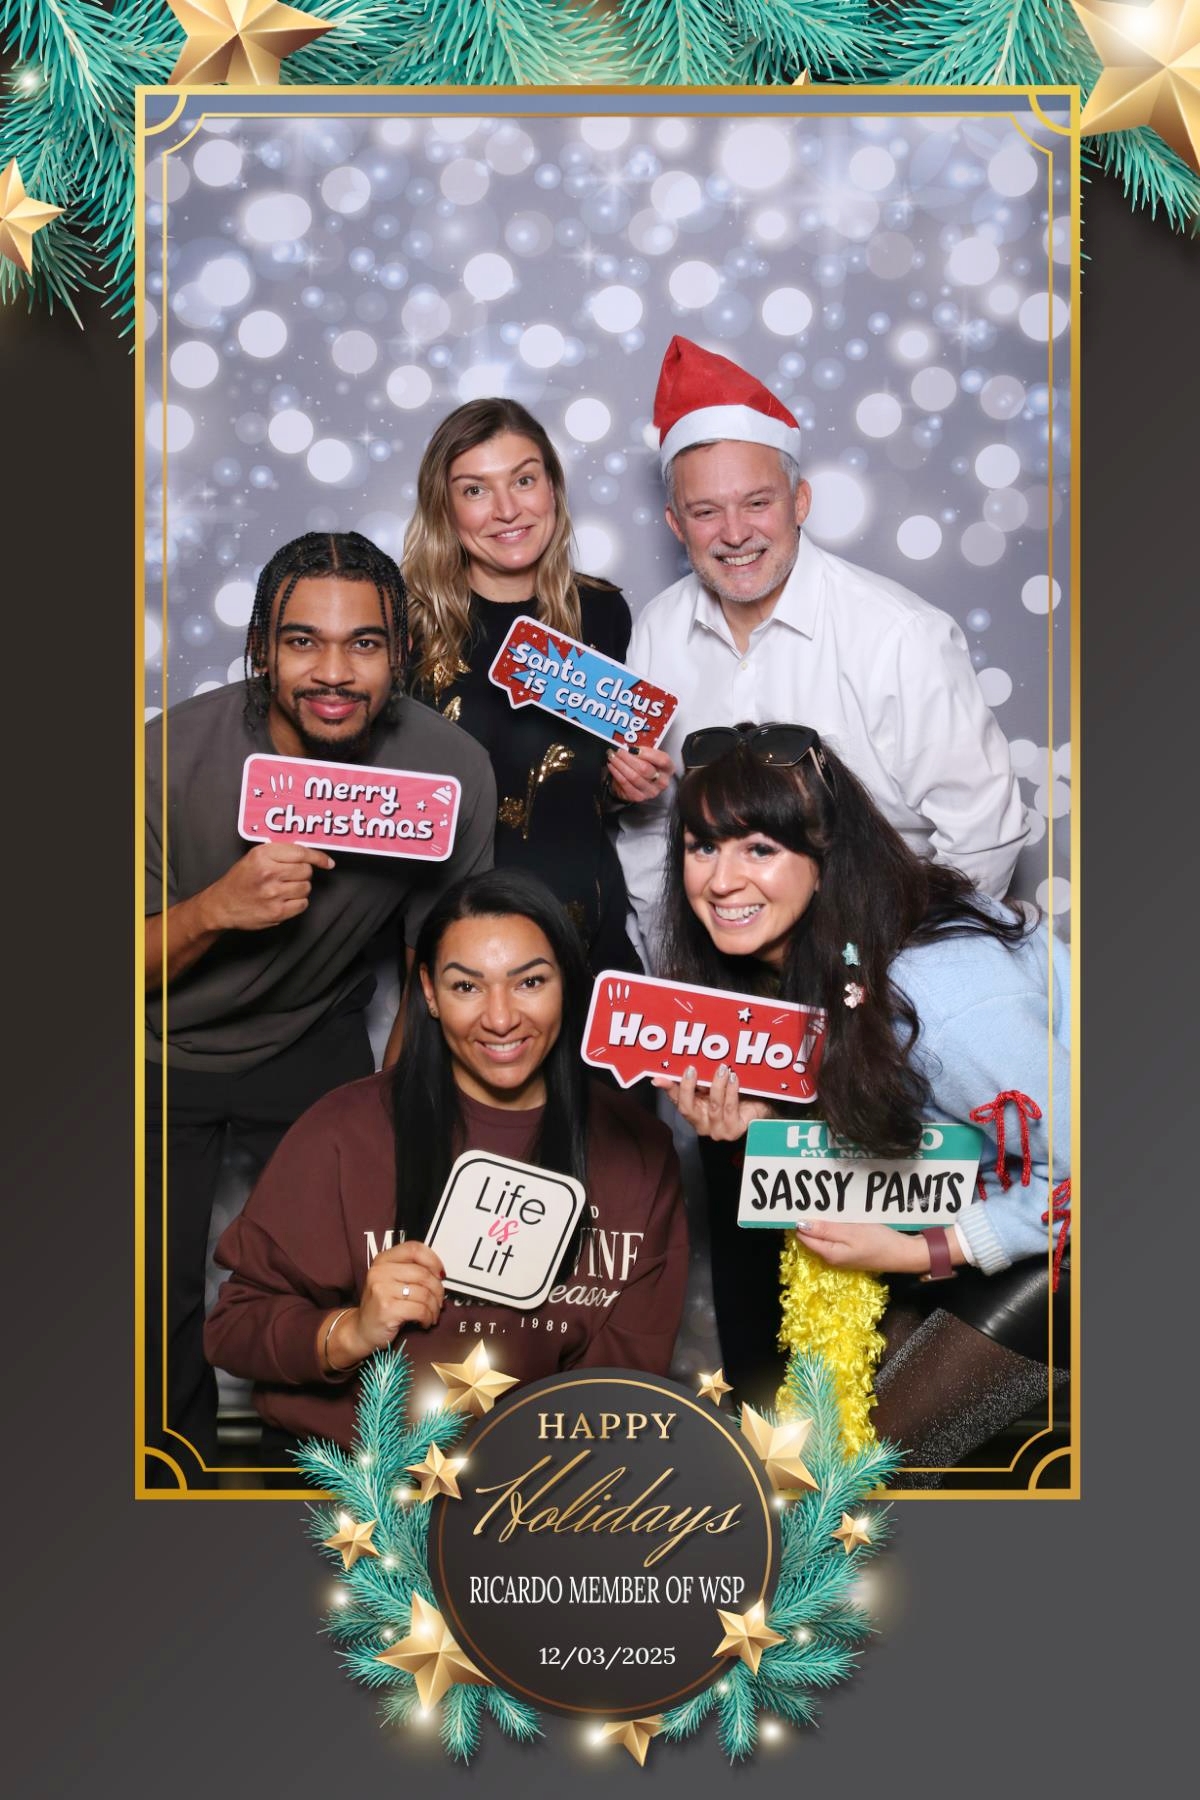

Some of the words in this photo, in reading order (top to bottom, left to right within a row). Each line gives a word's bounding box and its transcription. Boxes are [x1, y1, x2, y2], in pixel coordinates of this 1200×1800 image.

[511, 641, 587, 689] Santa
[596, 676, 665, 718] Claus
[523, 670, 548, 695] is
[555, 688, 648, 744] coming
[304, 776, 400, 816] Merry
[264, 804, 434, 840] Christmas
[608, 1011, 667, 1051] Ho
[671, 1020, 730, 1060] Ho
[735, 1029, 816, 1074] Ho!
[800, 1149, 828, 1158] MY
[475, 1175, 547, 1226] Life
[750, 1168, 854, 1212] SASSY
[865, 1171, 965, 1214] PANTS
[487, 1215, 520, 1244] is
[468, 1236, 515, 1277] Lit
[459, 1321, 506, 1334] EST.
[520, 1316, 568, 1334] 1989
